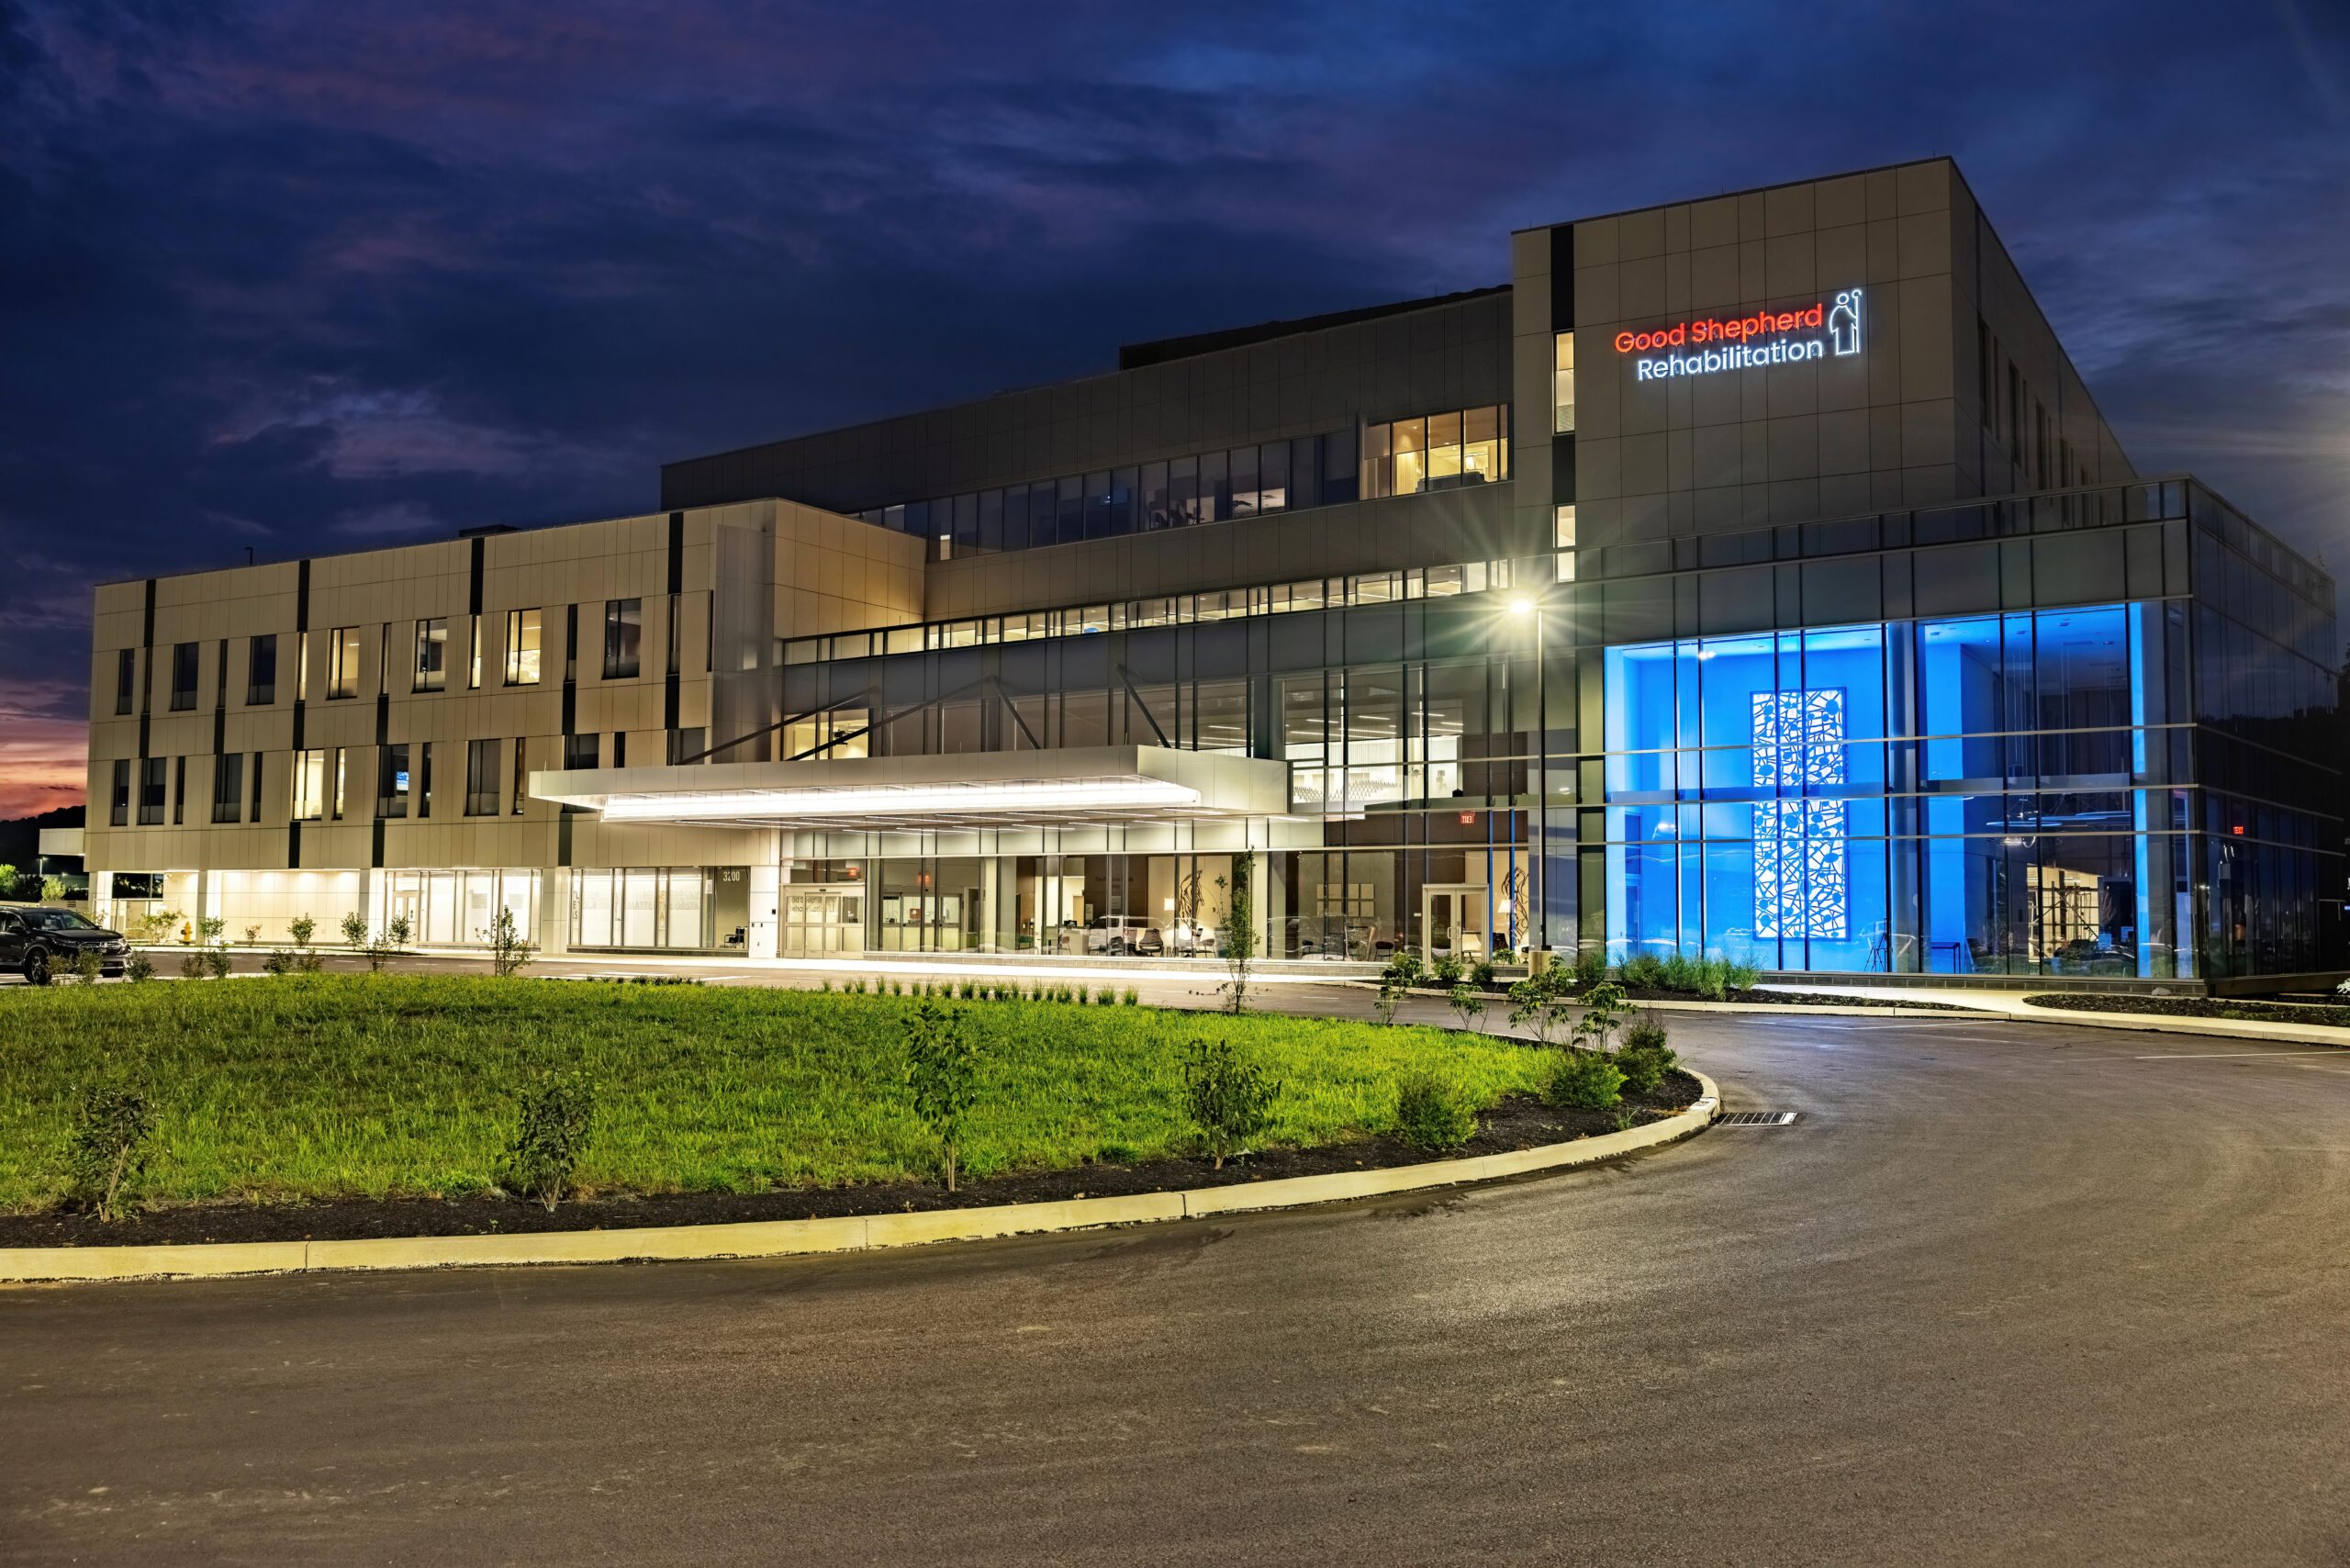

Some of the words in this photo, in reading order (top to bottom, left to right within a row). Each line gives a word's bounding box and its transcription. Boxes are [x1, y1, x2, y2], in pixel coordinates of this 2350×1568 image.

[1615, 323, 1685, 353] Good
[1691, 304, 1823, 343] Shepherd
[1638, 339, 1824, 380] Rehabilitation
[722, 870, 740, 881] 3200
